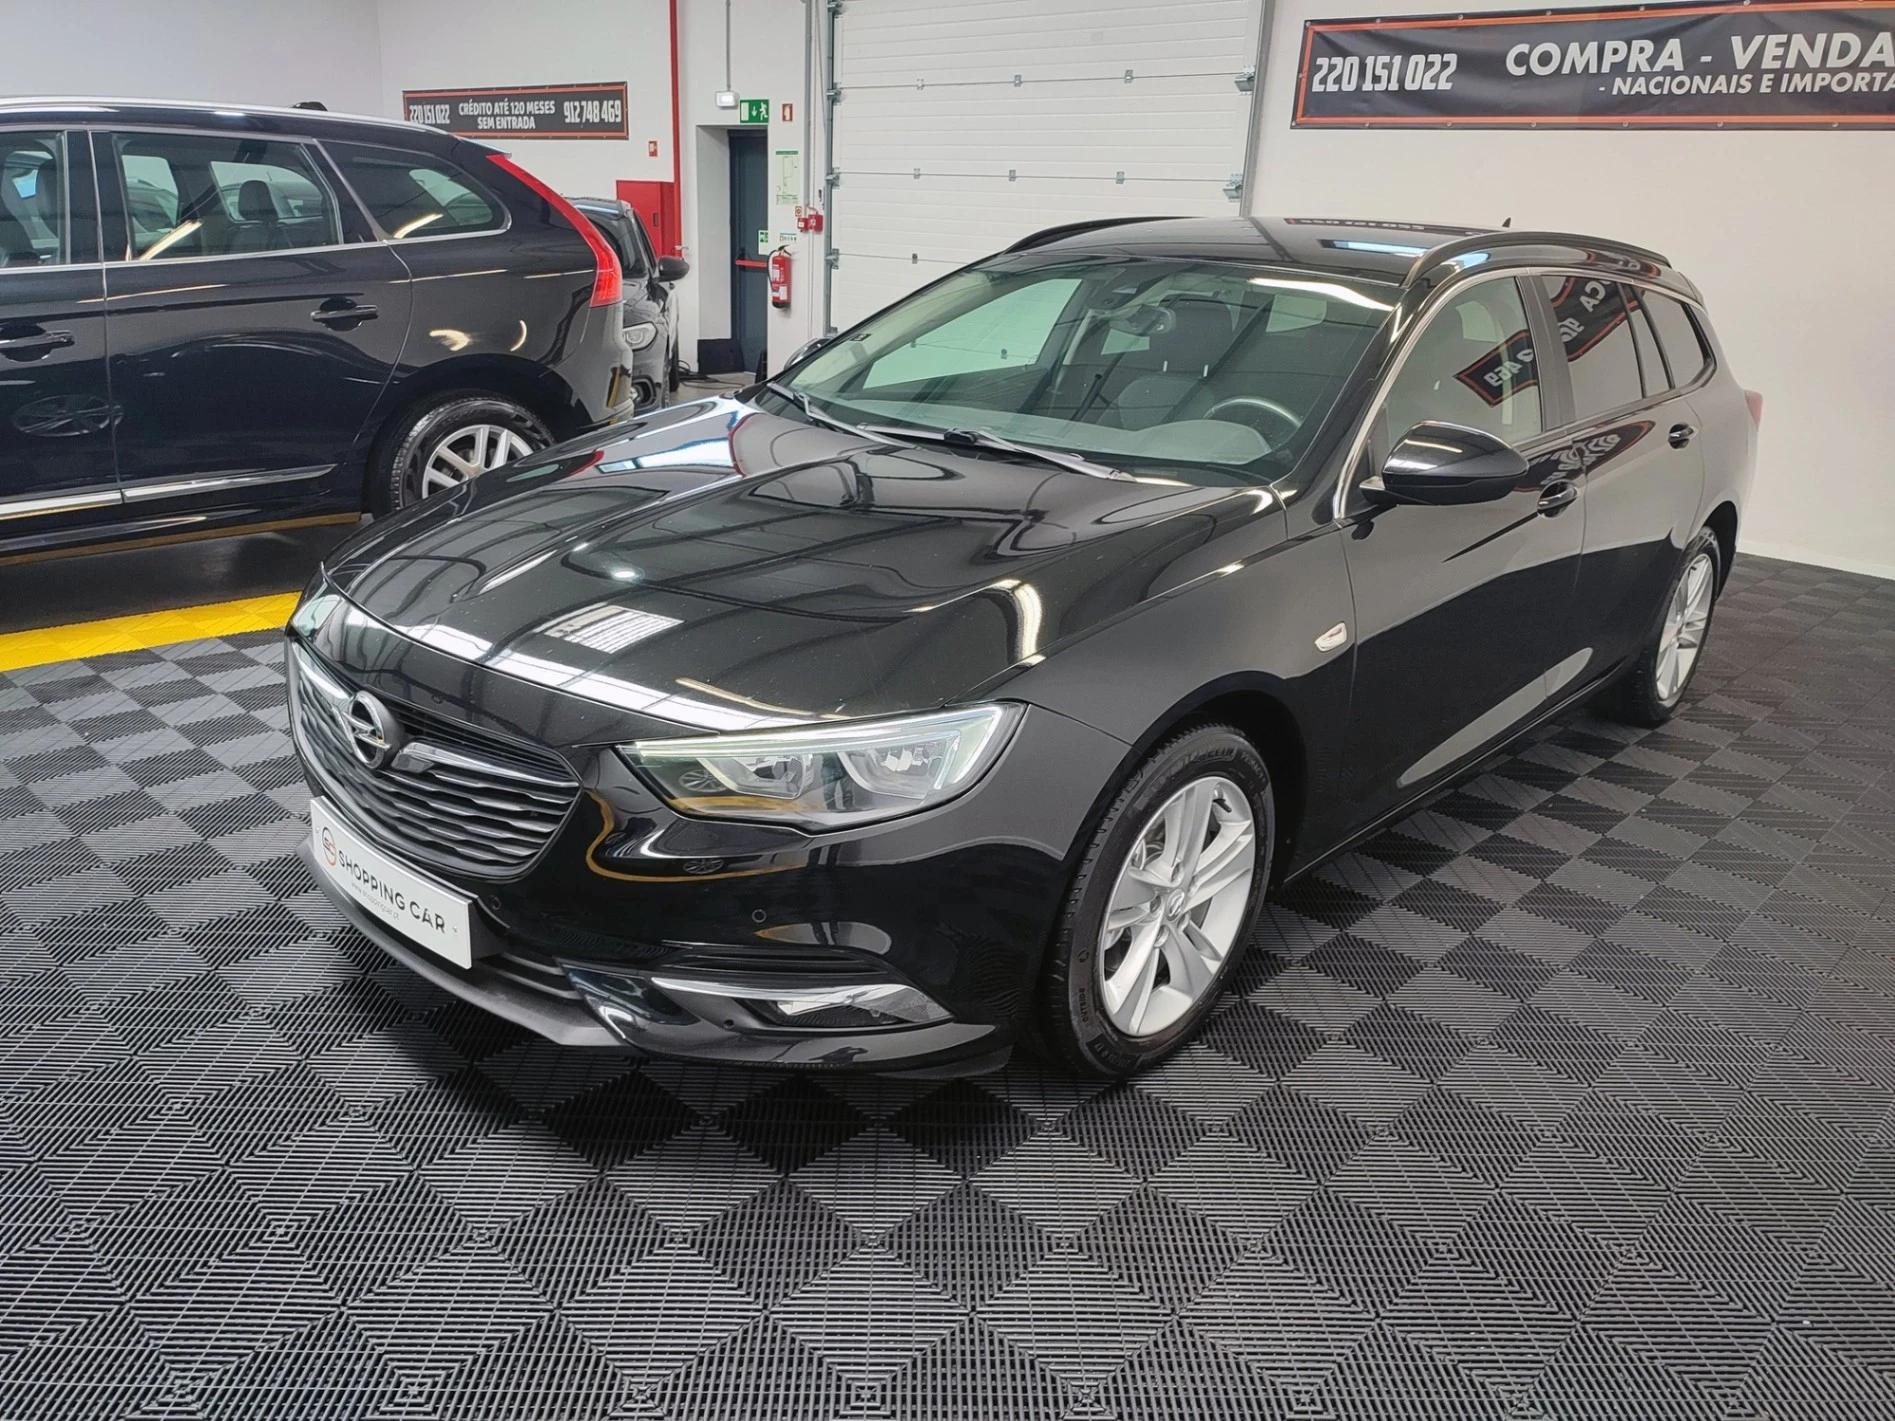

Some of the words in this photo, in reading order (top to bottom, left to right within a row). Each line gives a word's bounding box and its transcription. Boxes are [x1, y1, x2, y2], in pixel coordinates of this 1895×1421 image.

[1506, 39, 1684, 76] COMPRA
[1731, 32, 1895, 70] VENDA
[1312, 57, 1359, 92] 220
[1362, 55, 1402, 91] 151
[1404, 53, 1457, 90] 022
[1612, 74, 1753, 95] NACIONAIS
[1759, 74, 1774, 93] E
[409, 104, 423, 124] 220
[424, 105, 434, 124] 151
[435, 104, 450, 124] 022
[459, 99, 492, 116] CRÉDITO
[494, 98, 509, 115] ATÉ
[510, 102, 525, 114] 120
[526, 101, 555, 114] MESES
[563, 101, 580, 123] 912
[581, 101, 600, 122] 748
[601, 101, 622, 122] 469
[477, 117, 495, 129] SEM
[496, 116, 535, 129] ENTRADA
[338, 851, 406, 910] SHOPPING
[409, 901, 446, 934] CAR
